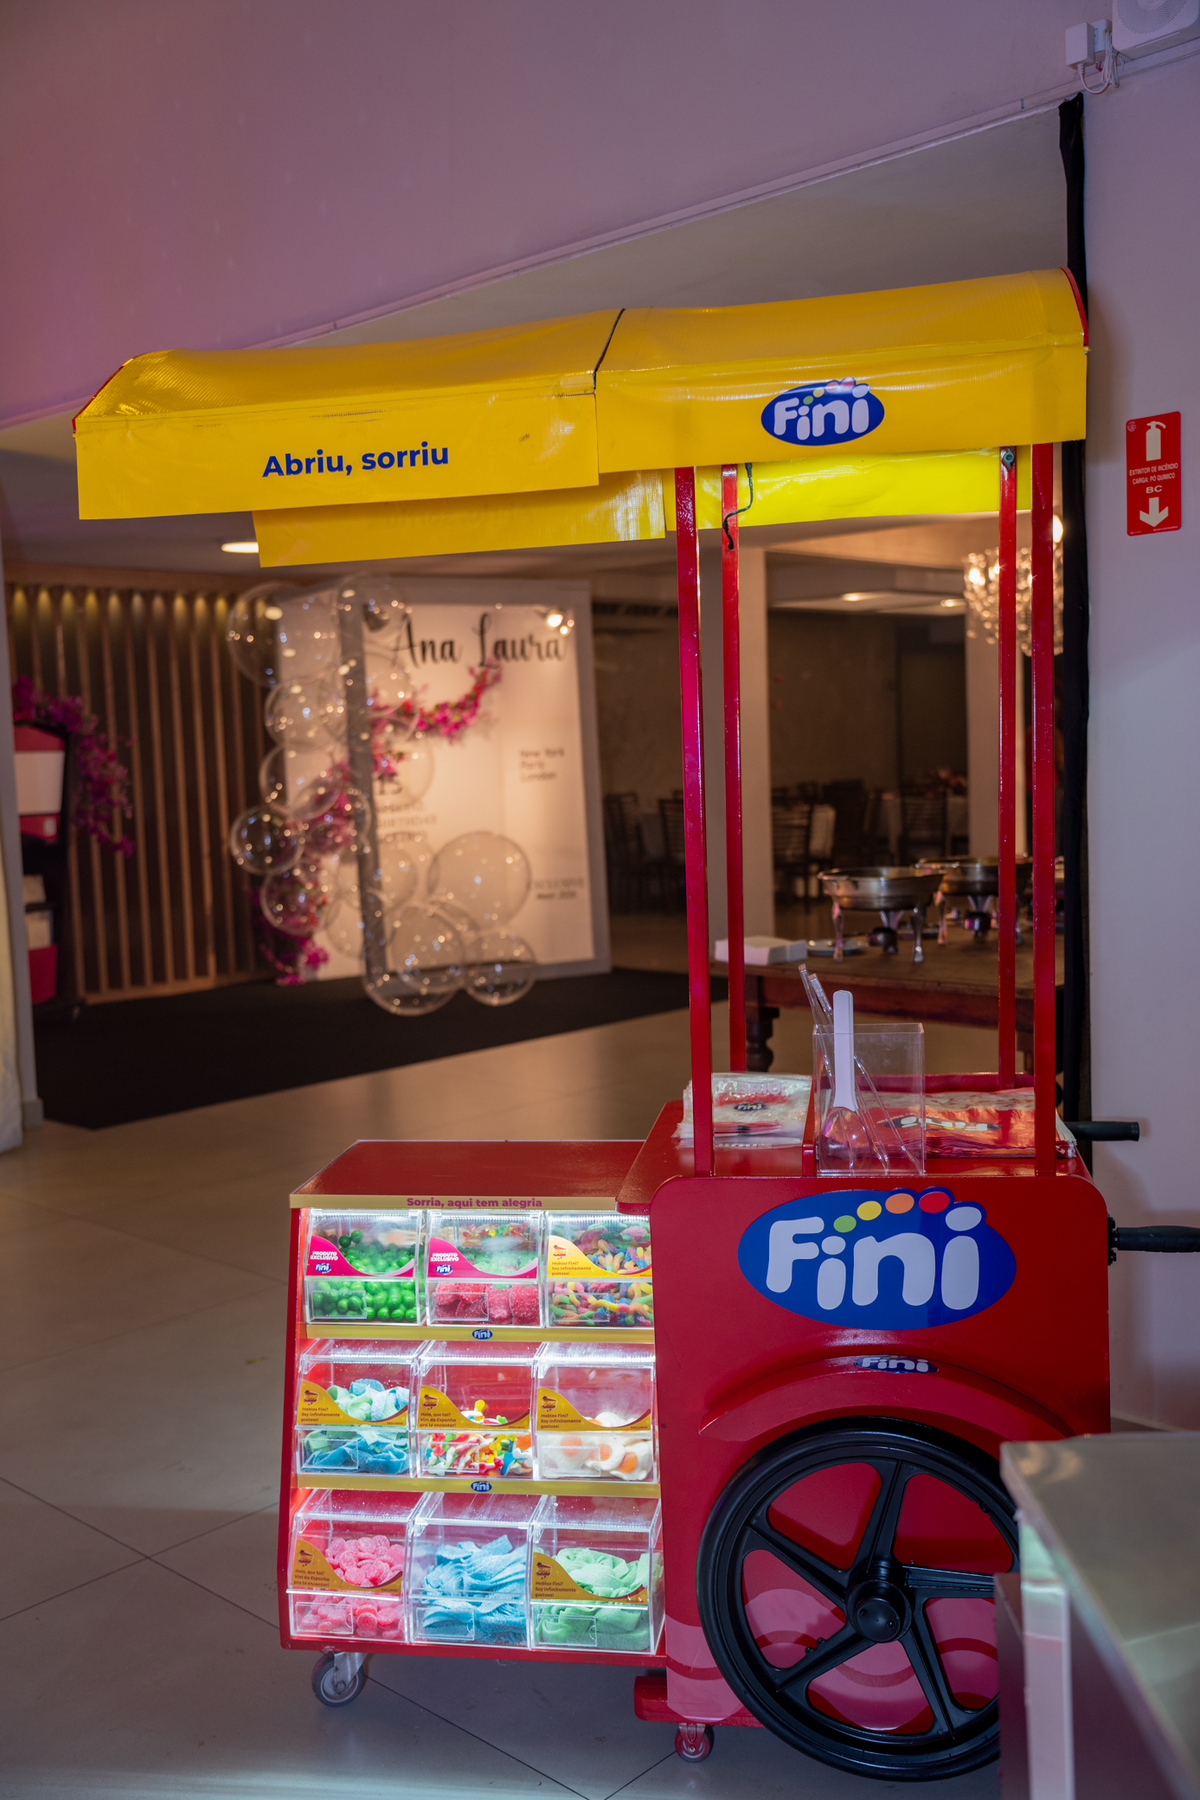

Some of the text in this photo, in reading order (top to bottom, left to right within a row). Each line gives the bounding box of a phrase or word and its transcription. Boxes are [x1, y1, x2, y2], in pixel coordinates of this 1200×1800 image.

[774, 385, 869, 441] Fini
[262, 441, 449, 478] Abriu, sorriu
[387, 611, 569, 669] Ana Laura
[407, 1197, 543, 1209] Sorria, aqui tem alegria
[766, 1206, 982, 1310] Fini
[473, 1330, 491, 1339] Fini
[860, 1357, 929, 1372] Fini
[472, 1482, 490, 1491] Fini
